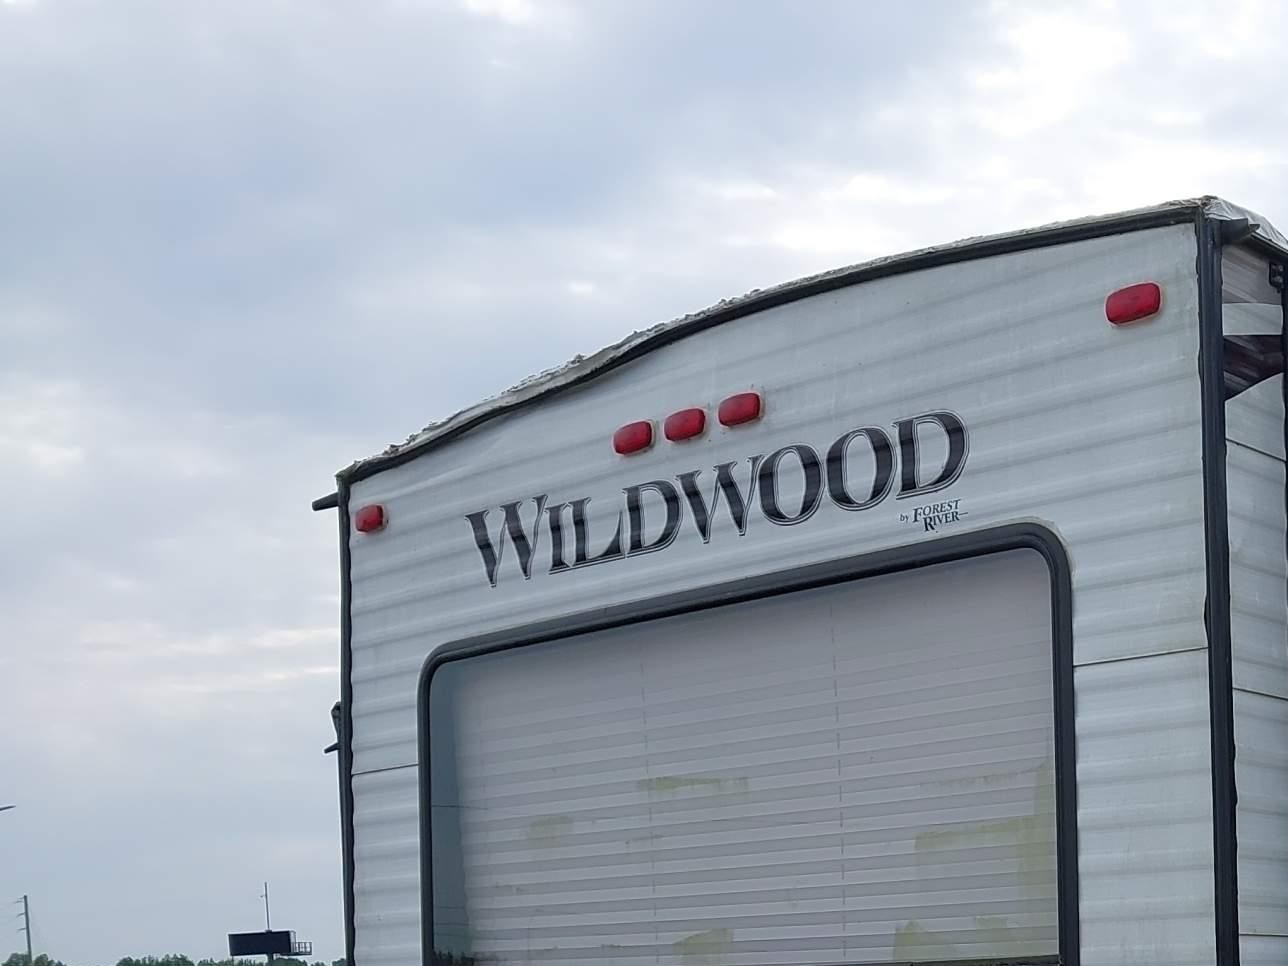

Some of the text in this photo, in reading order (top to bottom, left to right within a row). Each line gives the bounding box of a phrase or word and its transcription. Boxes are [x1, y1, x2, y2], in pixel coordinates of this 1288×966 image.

[464, 408, 970, 588] WILDWOOD
[899, 499, 961, 524] by FOREST
[922, 511, 961, 532] RIVER
